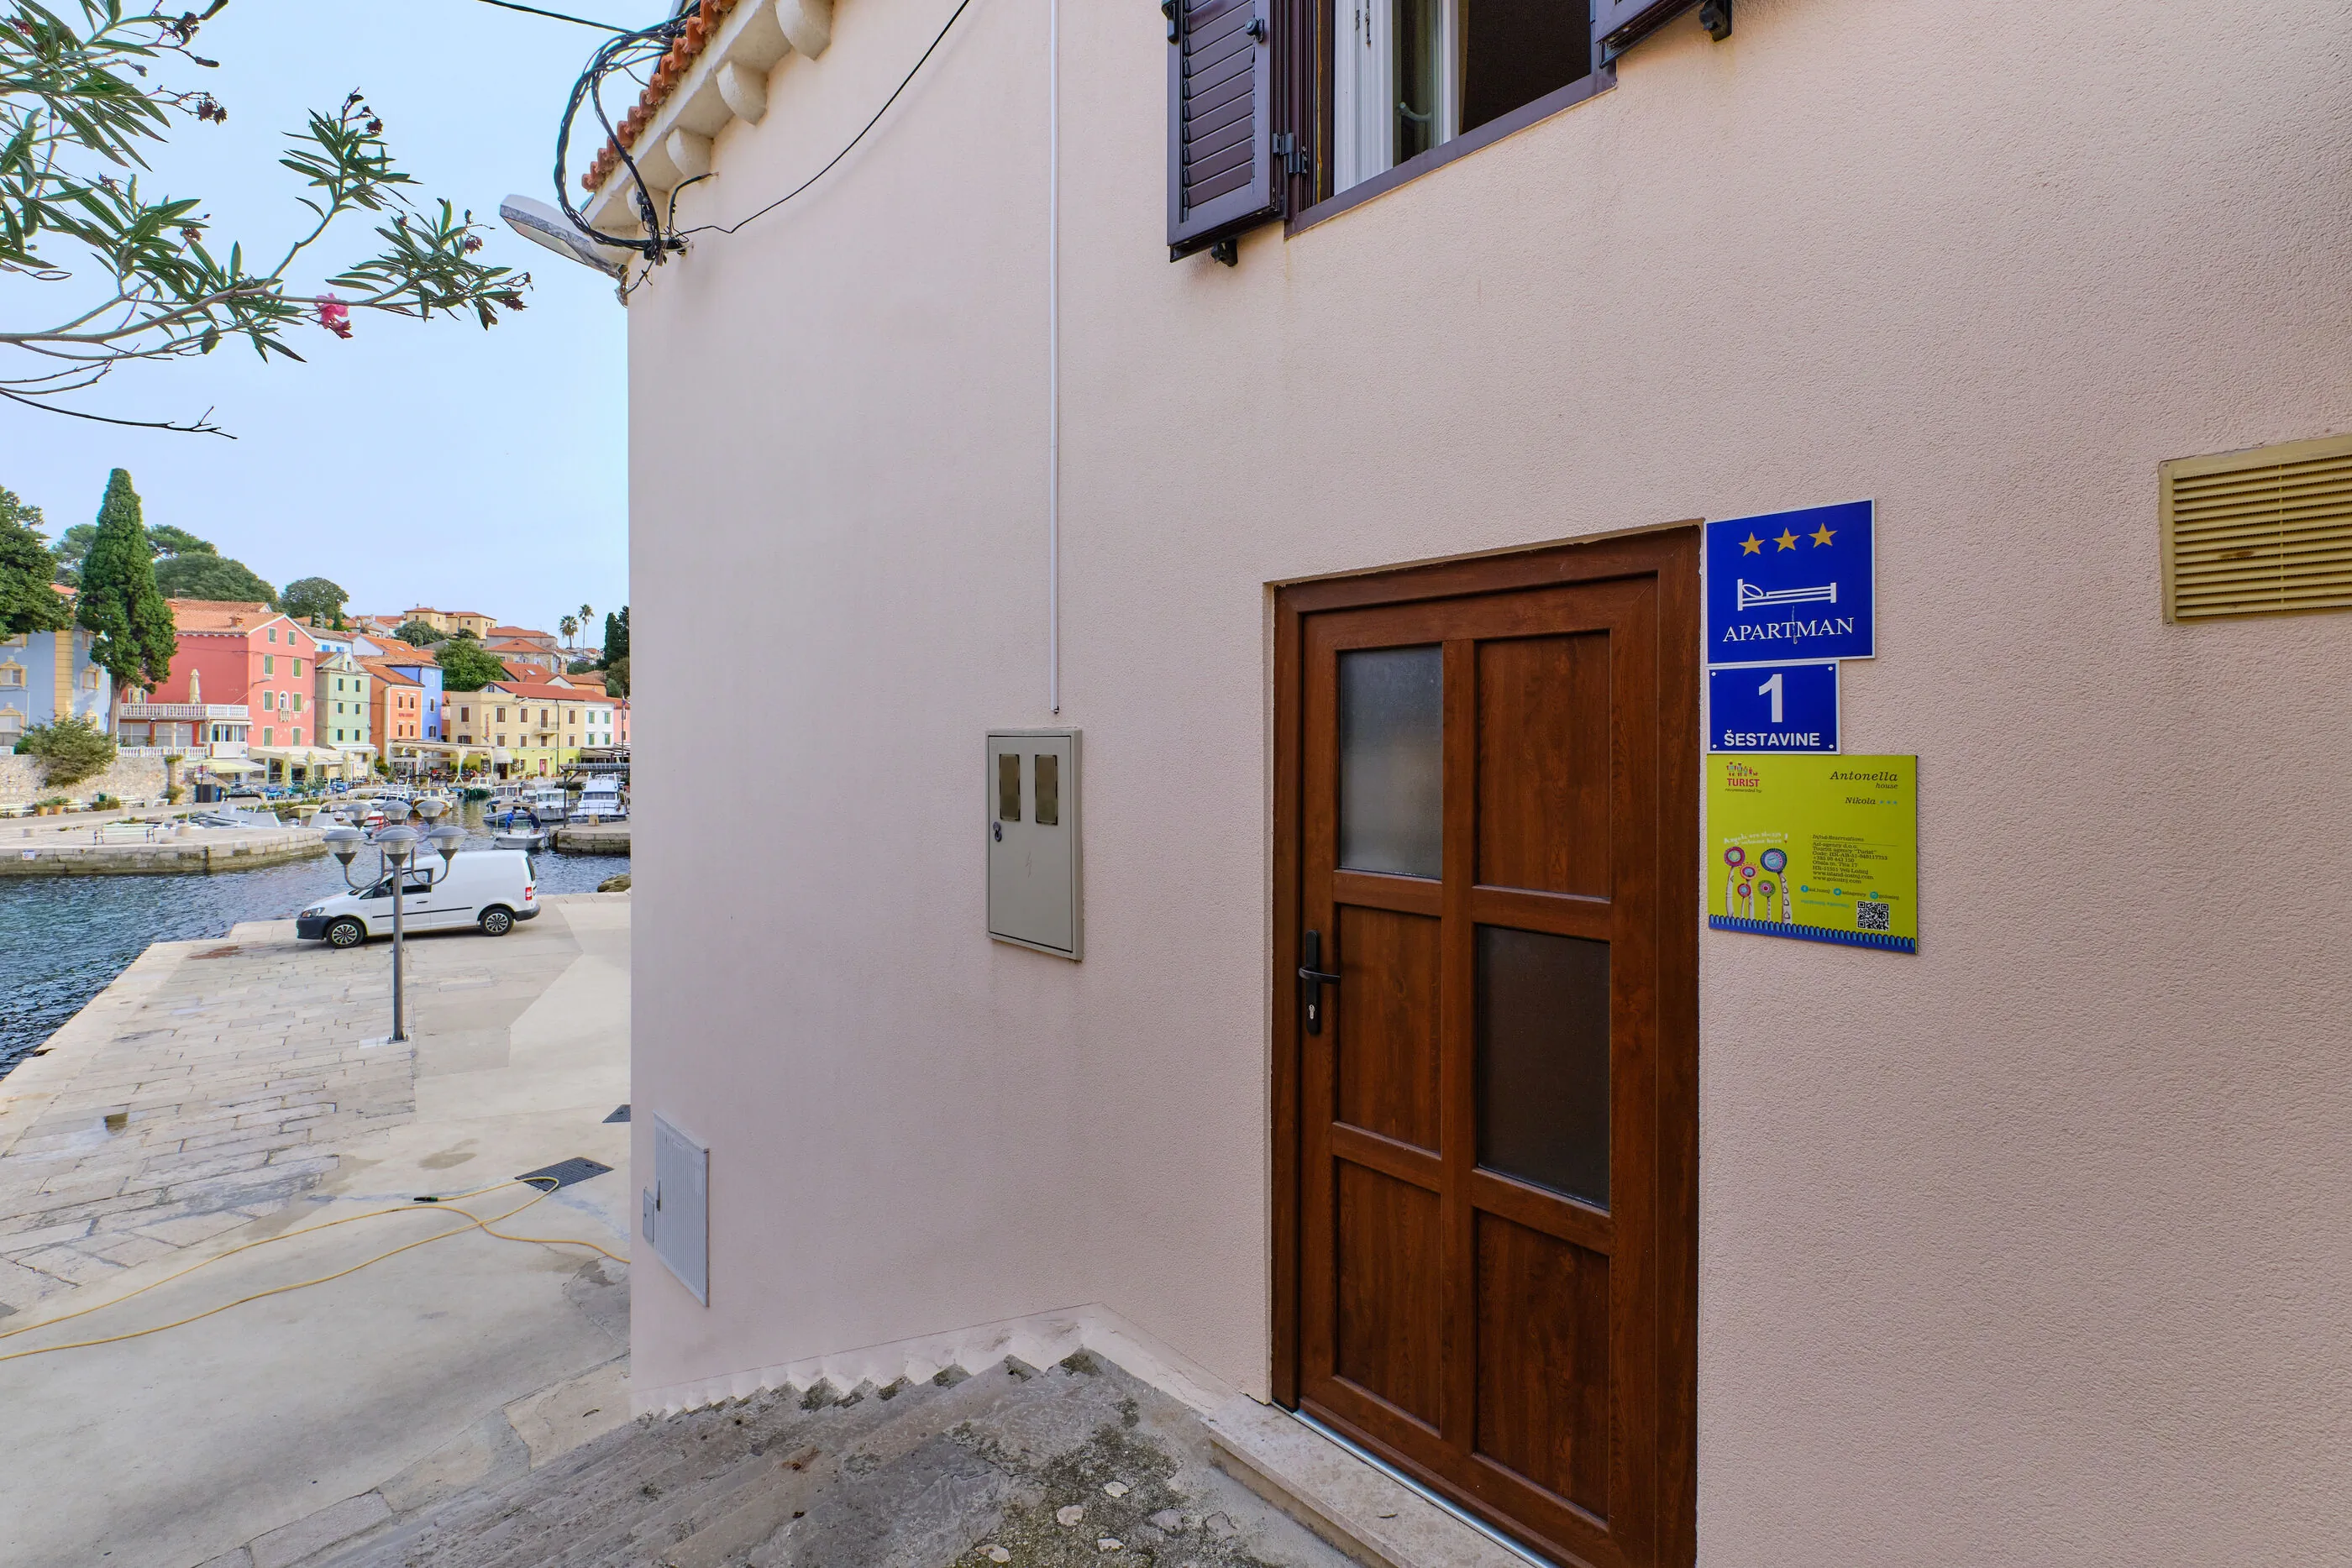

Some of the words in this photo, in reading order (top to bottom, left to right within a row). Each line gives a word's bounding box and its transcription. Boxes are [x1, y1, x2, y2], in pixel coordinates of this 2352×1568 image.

[1723, 617, 1854, 642] APARTMAN
[1759, 674, 1782, 723] 1
[1724, 729, 1821, 747] ŠESTAVINE
[1726, 778, 1760, 787] TURIST
[1830, 770, 1898, 782] Antonella
[1845, 796, 1876, 805] Nikola
